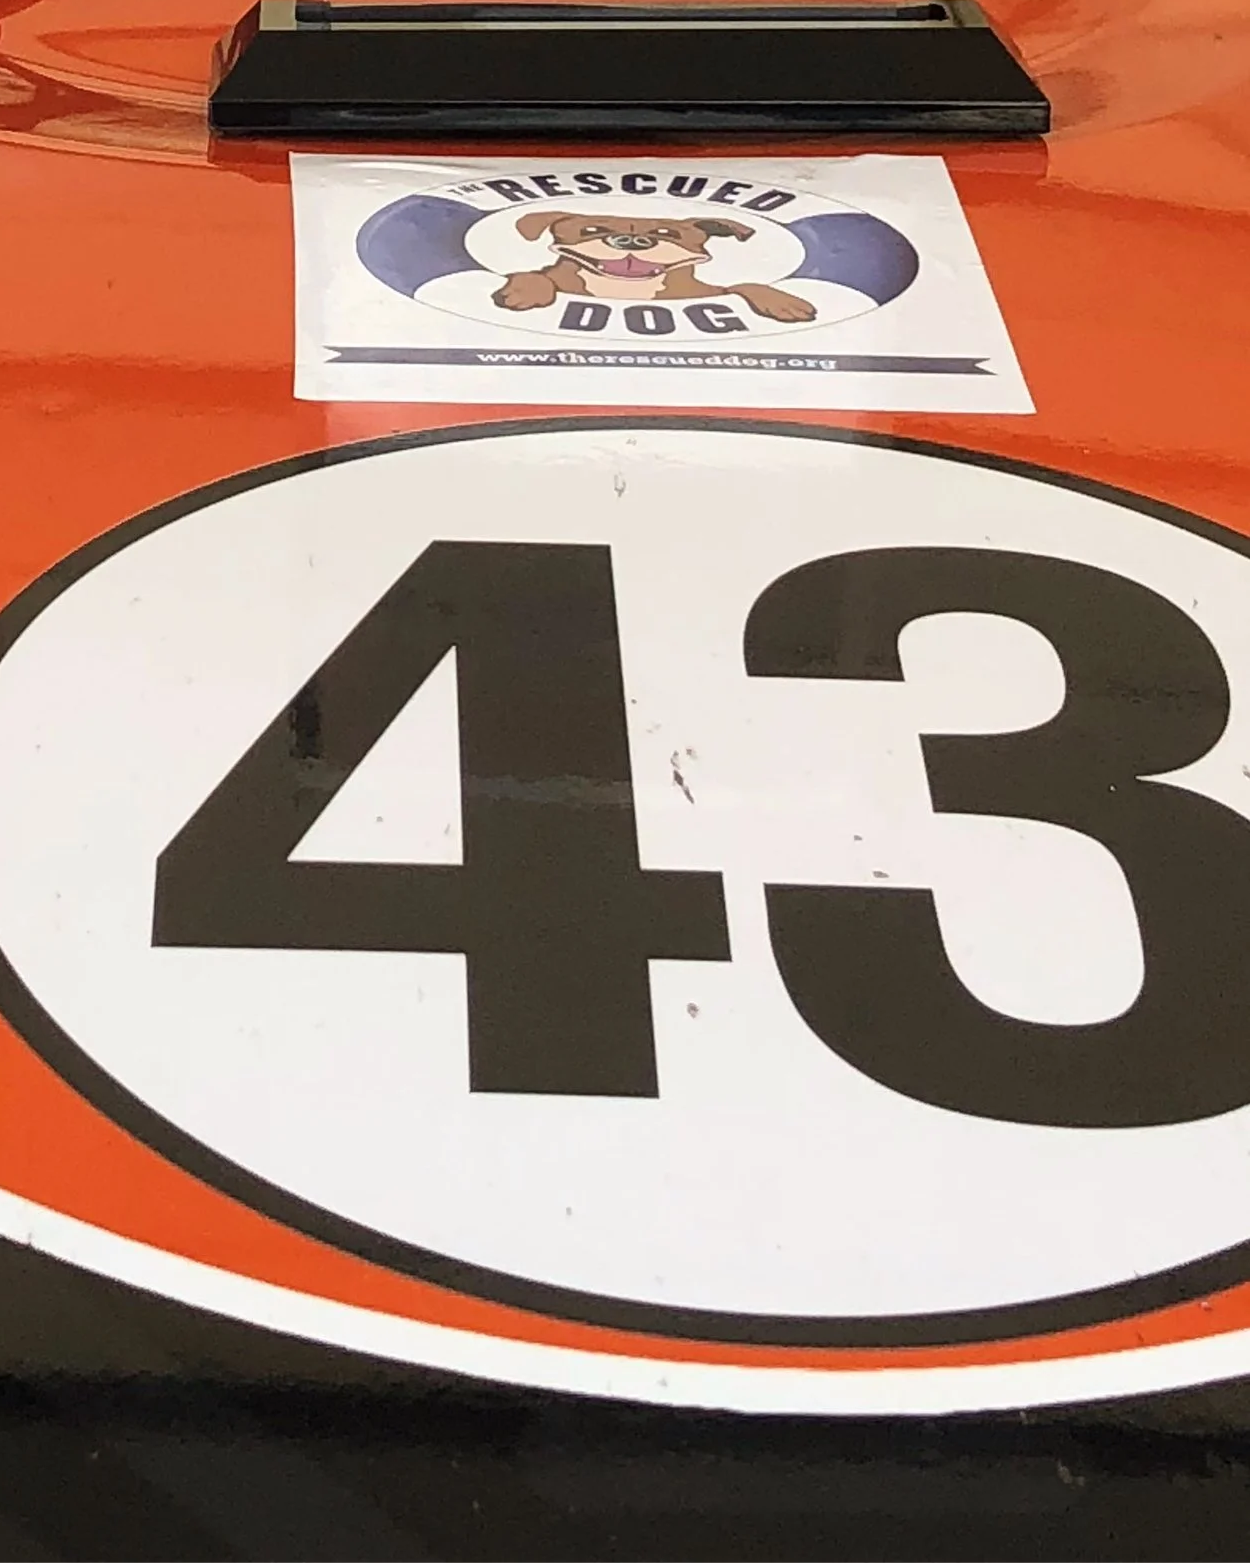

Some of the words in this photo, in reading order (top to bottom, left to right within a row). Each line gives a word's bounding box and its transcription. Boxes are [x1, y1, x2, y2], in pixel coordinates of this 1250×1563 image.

[483, 172, 797, 212] RESCUED
[558, 301, 750, 336] DOG
[476, 350, 837, 372] www.therescueddog.org
[151, 538, 1250, 1129] 43
